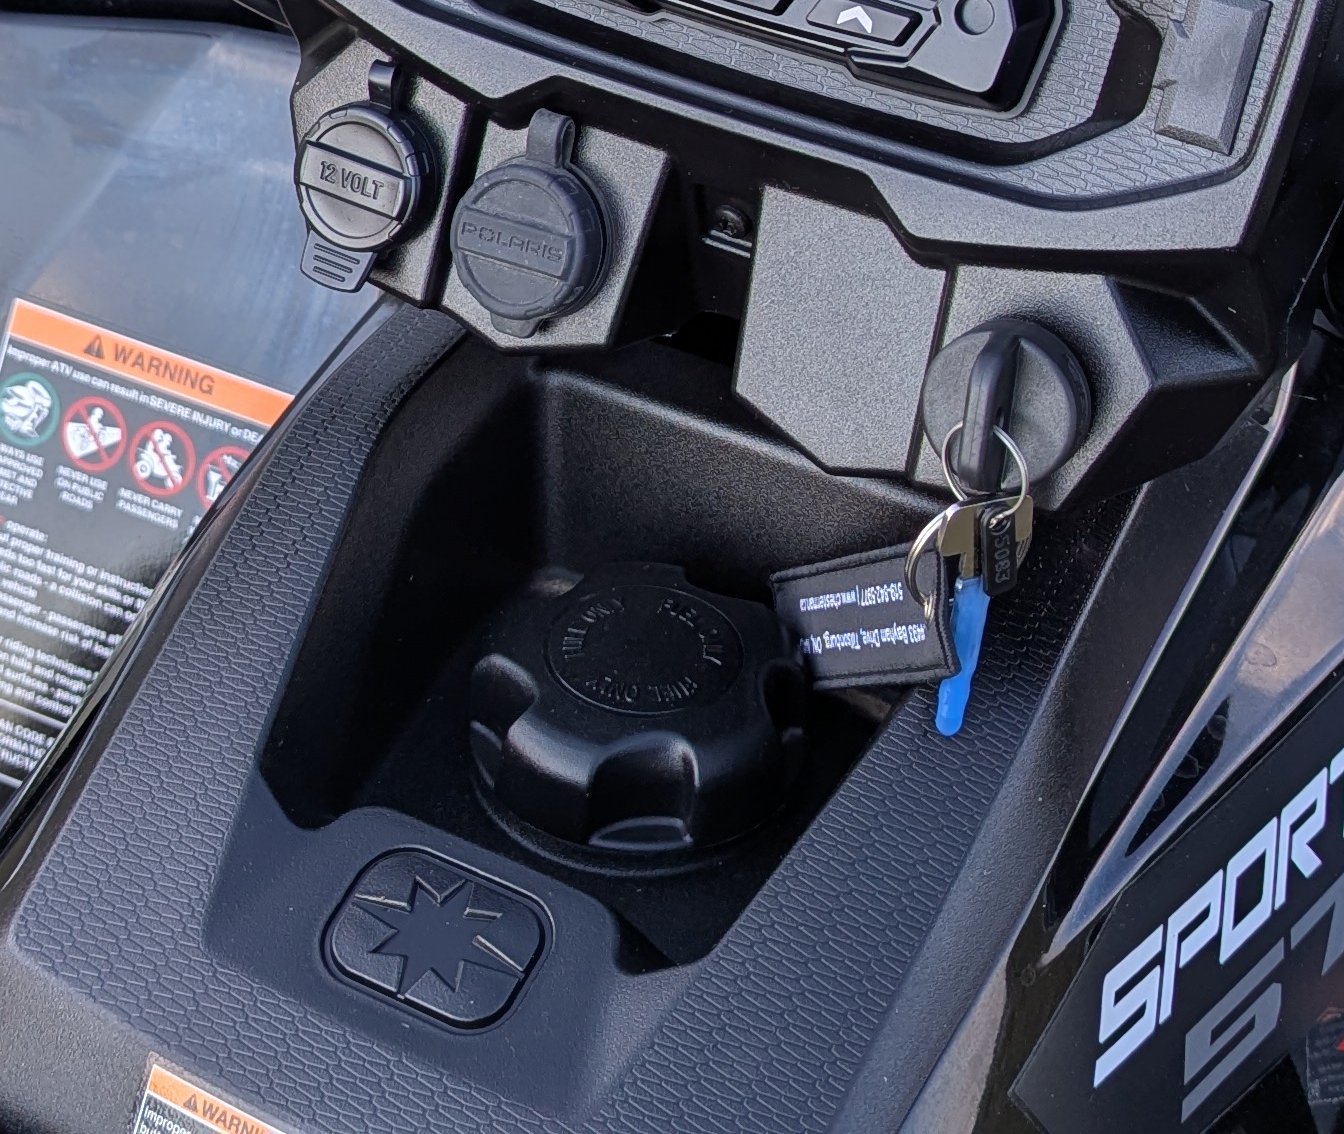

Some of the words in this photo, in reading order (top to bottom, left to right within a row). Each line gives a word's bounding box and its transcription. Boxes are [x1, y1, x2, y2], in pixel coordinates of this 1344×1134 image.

[320, 160, 340, 183] 12
[341, 167, 385, 200] VOLT
[460, 221, 566, 263] POLARIS
[112, 342, 216, 396] WARNING
